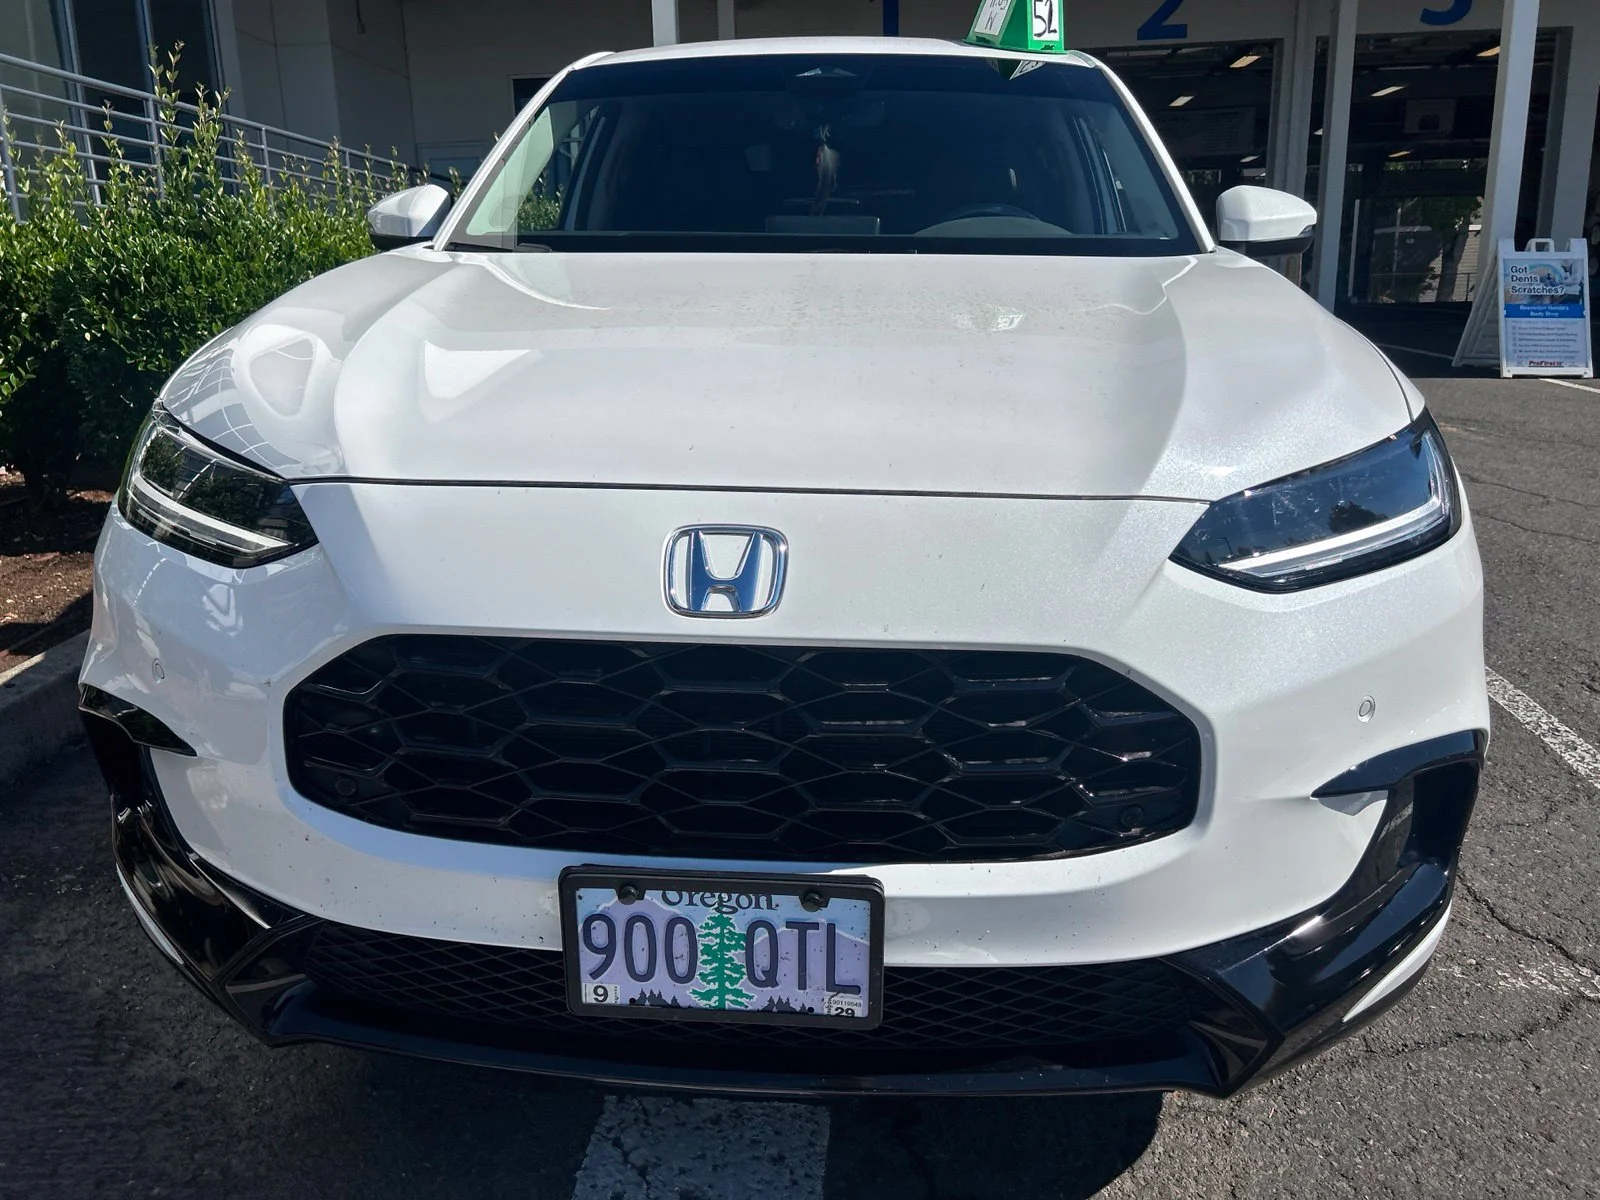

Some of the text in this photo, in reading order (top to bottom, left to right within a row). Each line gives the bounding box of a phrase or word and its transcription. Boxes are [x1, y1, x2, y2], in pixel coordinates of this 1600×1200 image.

[1034, 0, 1057, 37] 52
[1510, 265, 1528, 274] Got
[1510, 285, 1565, 294] Scratches?
[582, 913, 861, 995] 900 QTL
[593, 984, 609, 1003] 9
[834, 1006, 856, 1018] 29
